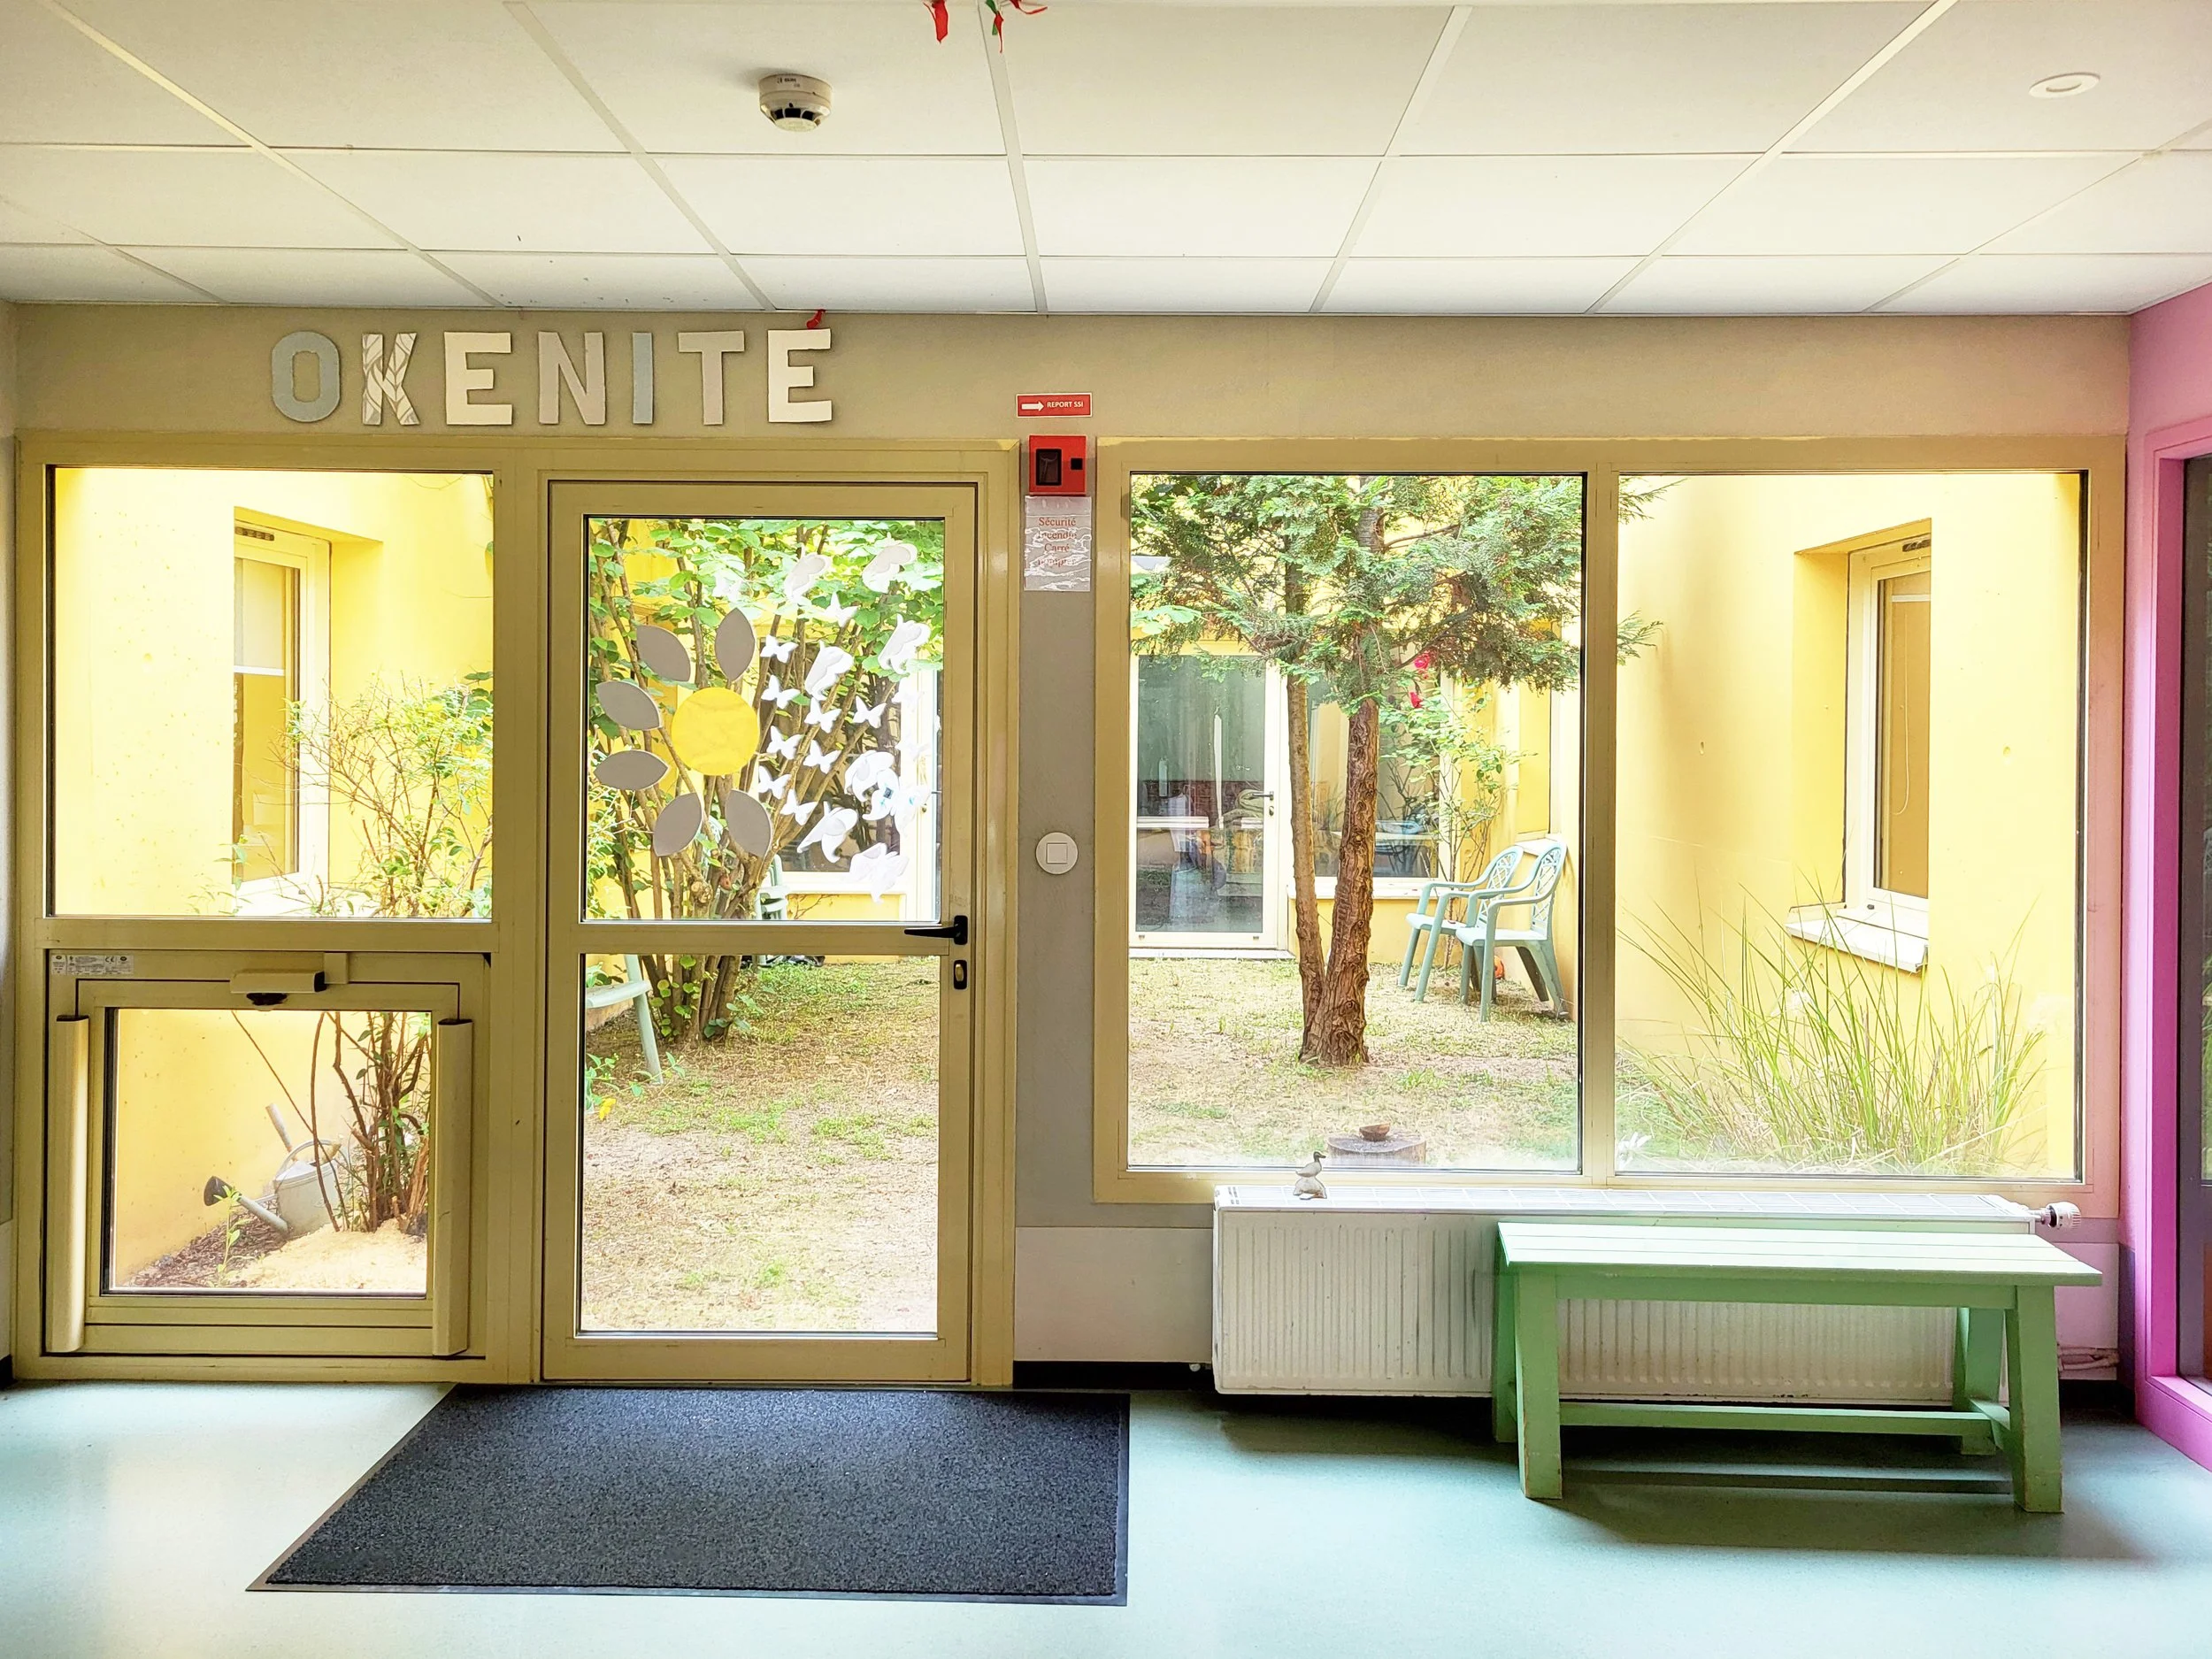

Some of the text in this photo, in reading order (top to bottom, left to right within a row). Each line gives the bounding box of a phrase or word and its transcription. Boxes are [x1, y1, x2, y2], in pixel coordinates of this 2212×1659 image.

[272, 328, 832, 425] OKENITE
[1039, 517, 1076, 526] Sécurité
[1044, 542, 1070, 552] Carré
